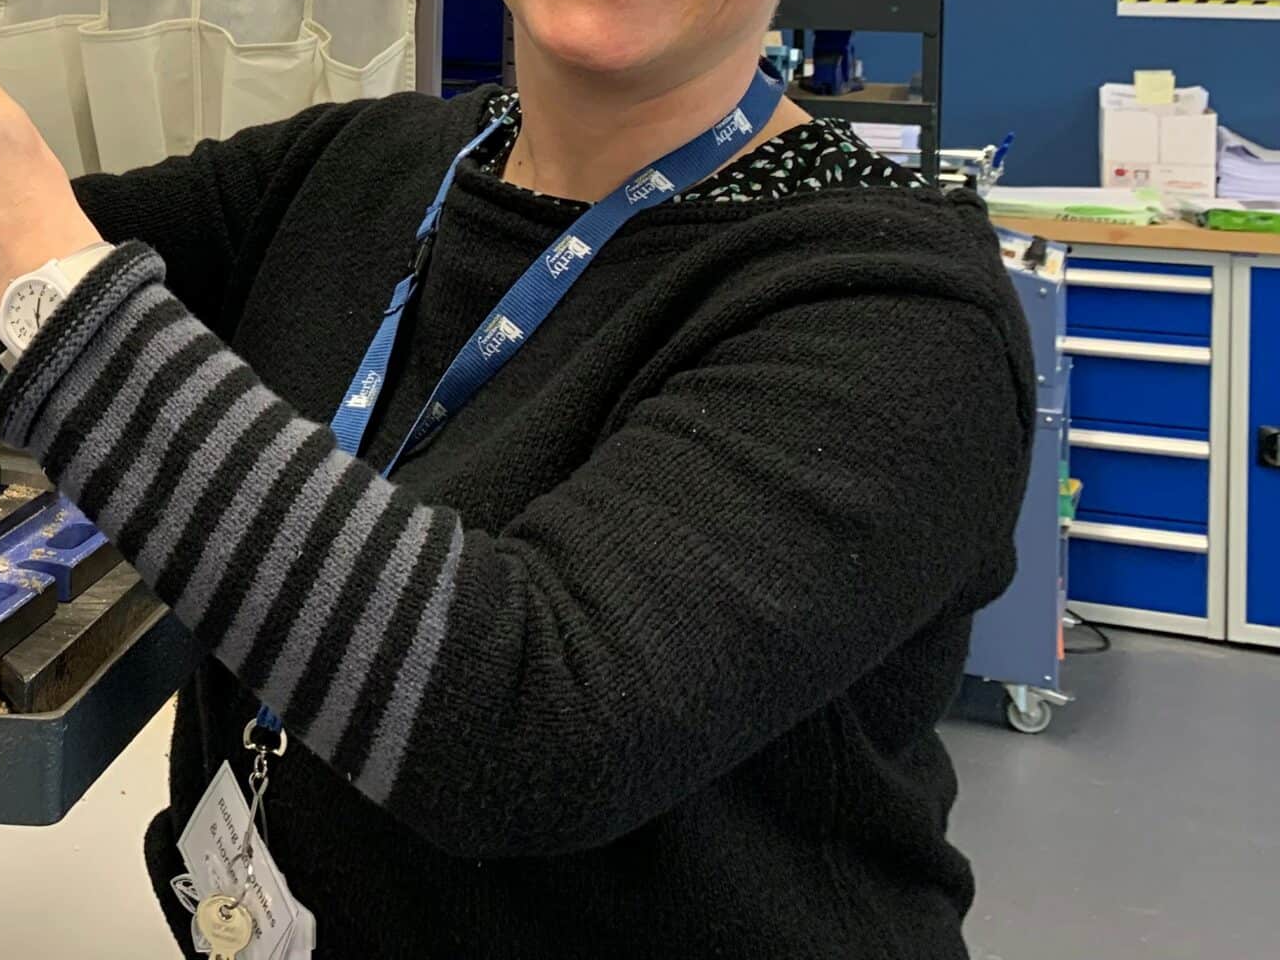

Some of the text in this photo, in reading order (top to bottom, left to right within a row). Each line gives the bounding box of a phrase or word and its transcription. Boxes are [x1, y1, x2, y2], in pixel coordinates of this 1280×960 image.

[712, 107, 753, 146] Derby
[624, 170, 676, 205] Derby
[545, 235, 592, 279] Derby
[477, 315, 524, 360] Derby
[345, 370, 381, 408] Derby
[209, 823, 217, 836] &
[218, 797, 239, 845] Riding
